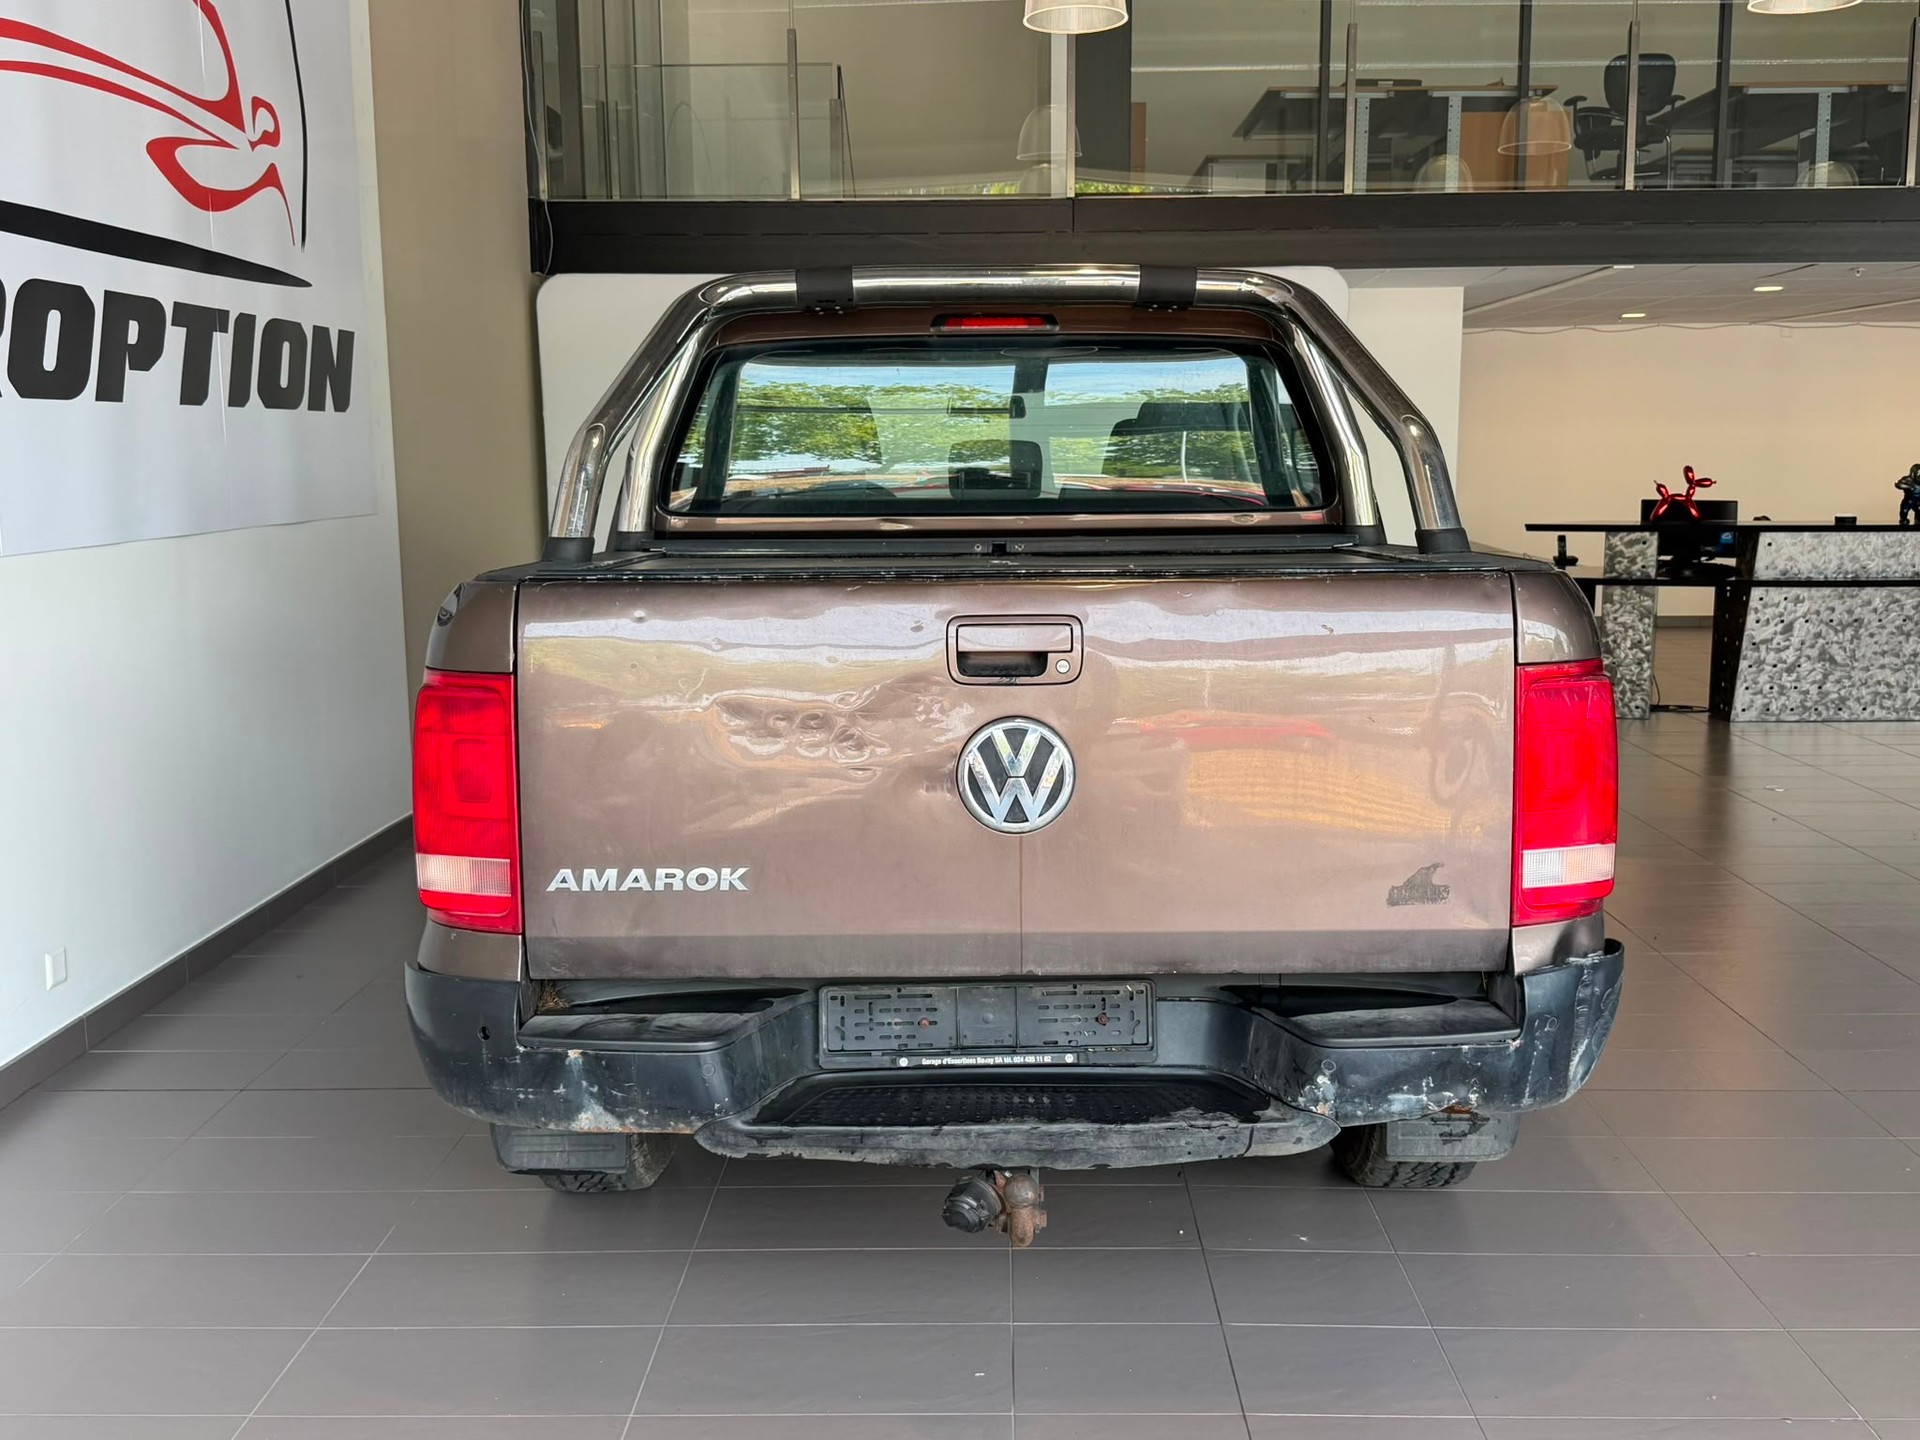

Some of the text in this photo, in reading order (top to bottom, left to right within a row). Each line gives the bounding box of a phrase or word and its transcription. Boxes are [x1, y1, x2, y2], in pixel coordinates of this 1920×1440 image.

[0, 278, 355, 413] OPTION
[545, 866, 750, 892] AMAROK
[921, 1058, 941, 1066] Garage
